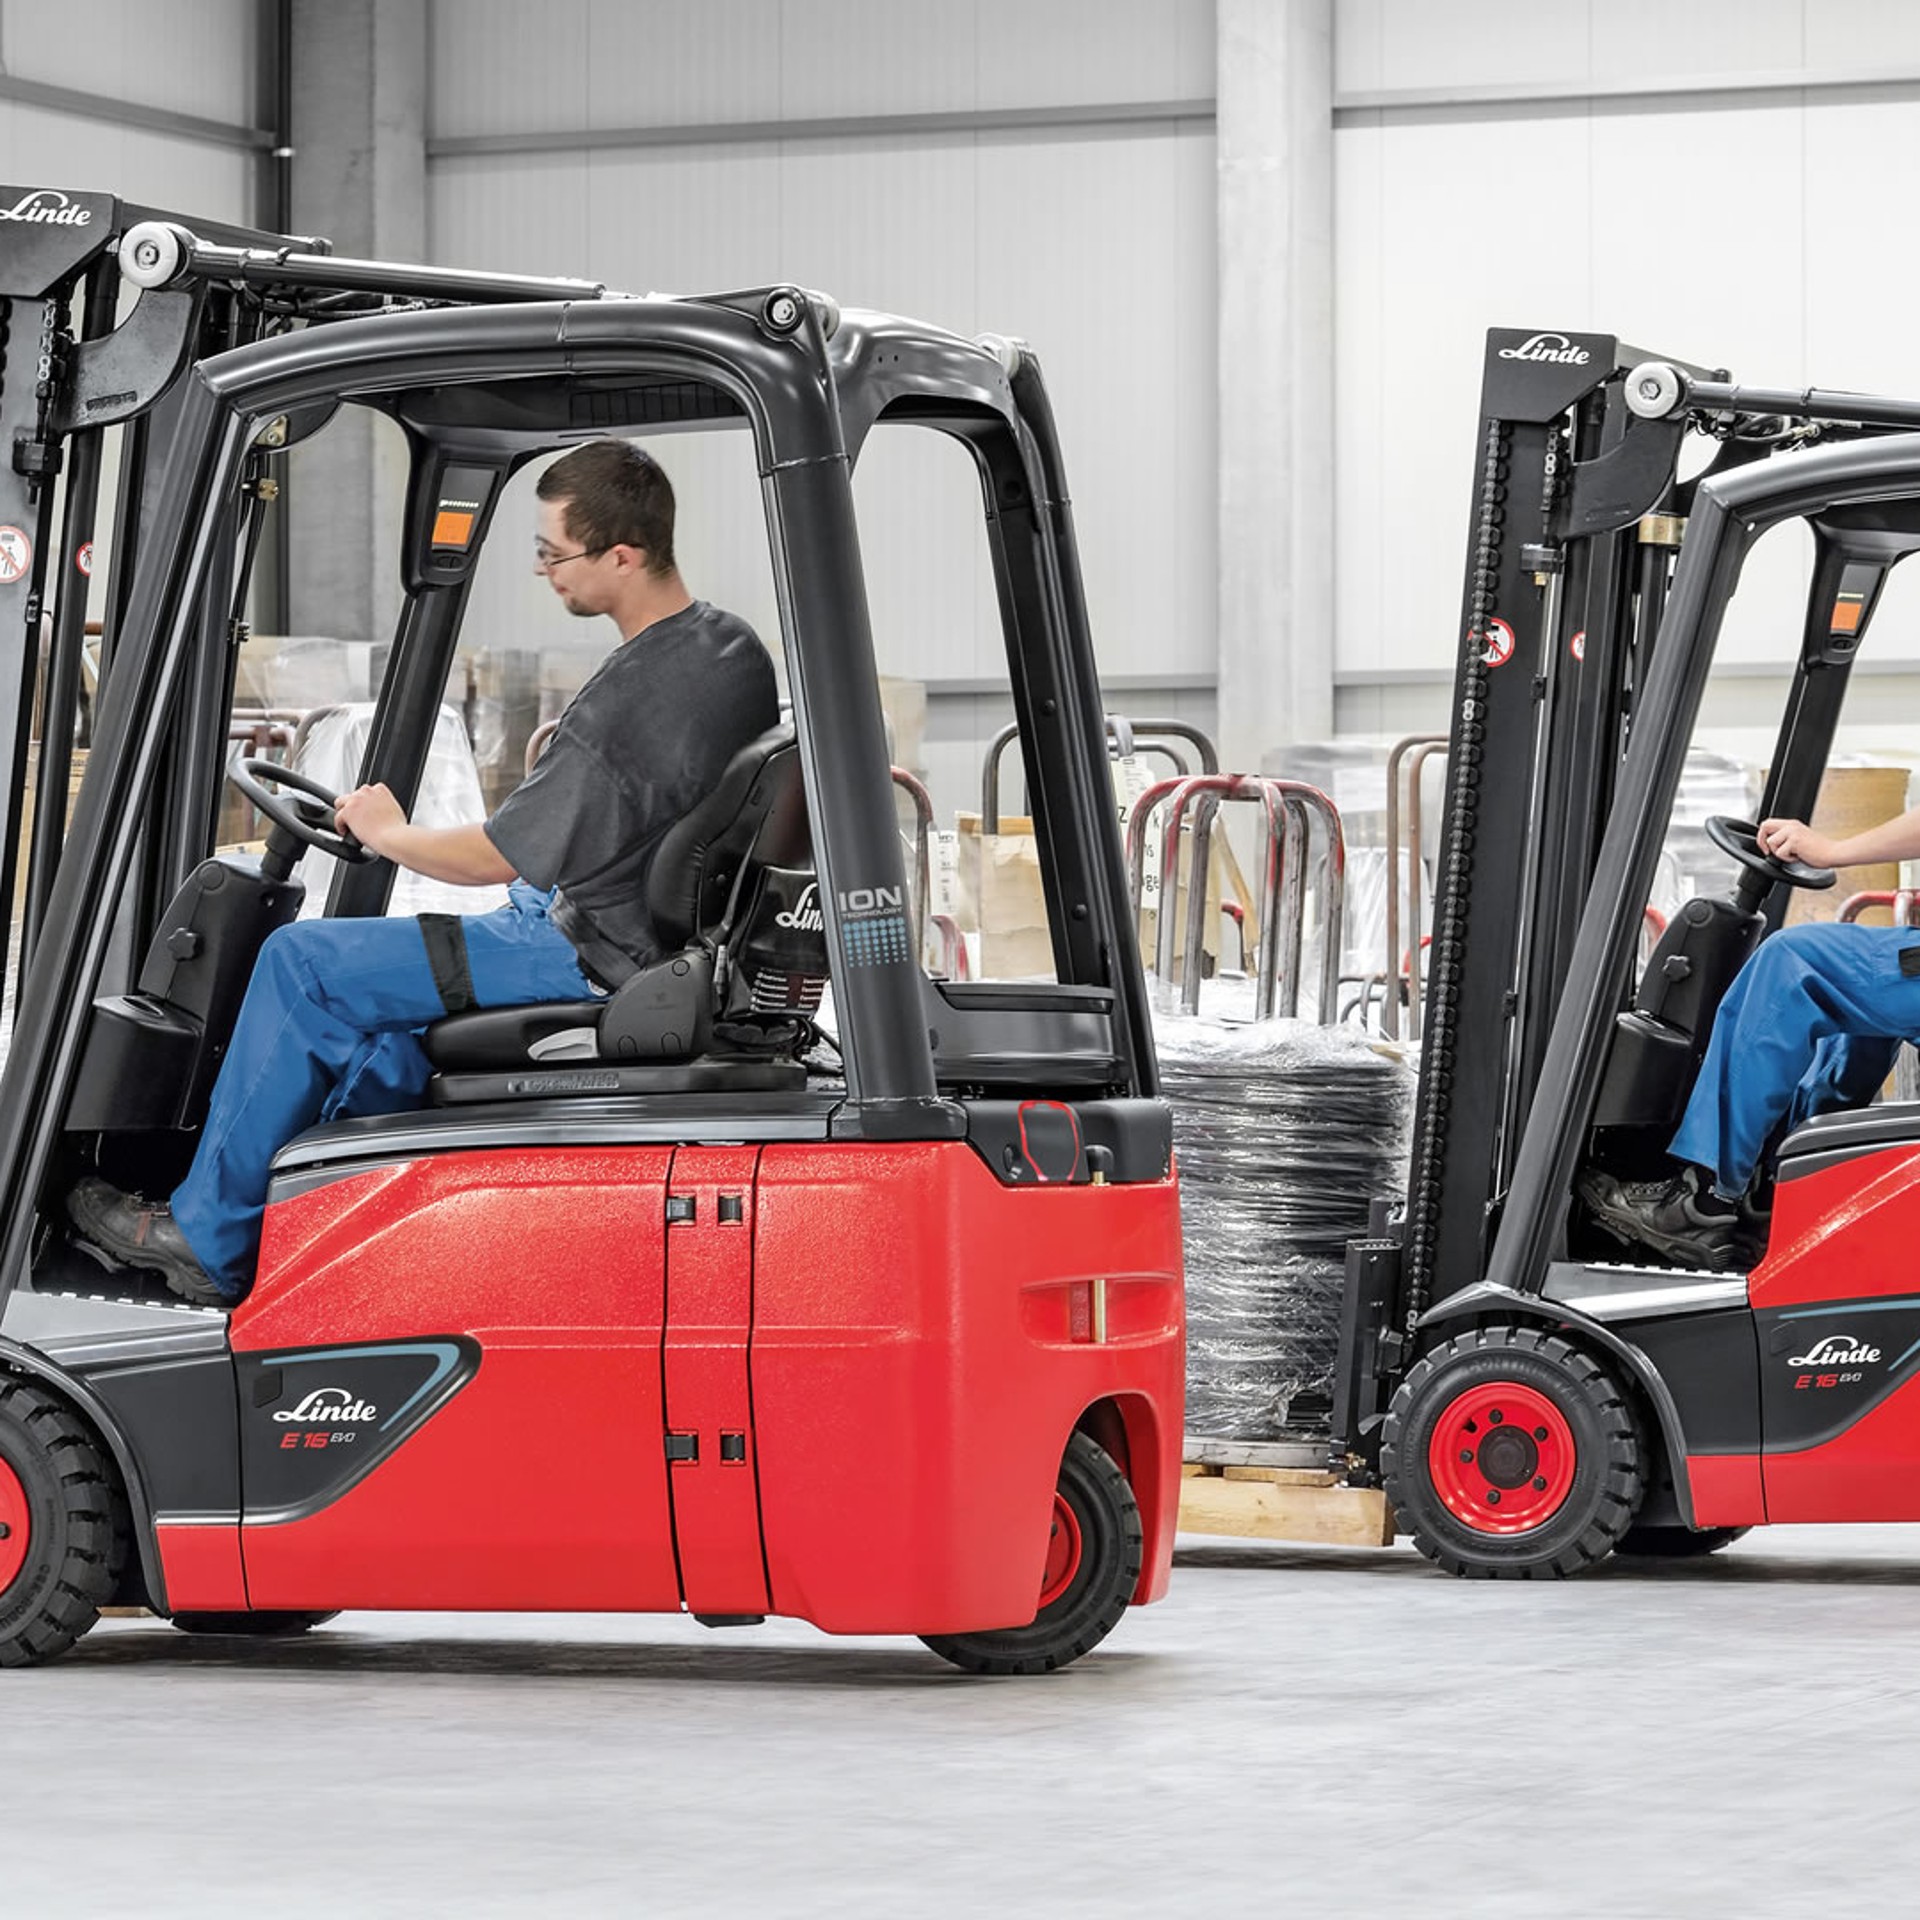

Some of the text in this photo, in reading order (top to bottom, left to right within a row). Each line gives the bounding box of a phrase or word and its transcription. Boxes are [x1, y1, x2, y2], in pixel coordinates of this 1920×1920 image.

[0, 190, 92, 227] Linde
[1498, 333, 1590, 365] Linde
[774, 882, 824, 931] Lin
[838, 885, 902, 912] ION
[1787, 1335, 1881, 1366] Linde
[1795, 1374, 1813, 1389] E
[1815, 1373, 1839, 1388] 16
[272, 1387, 377, 1423] Linde
[280, 1431, 356, 1449] E 16 EVO
